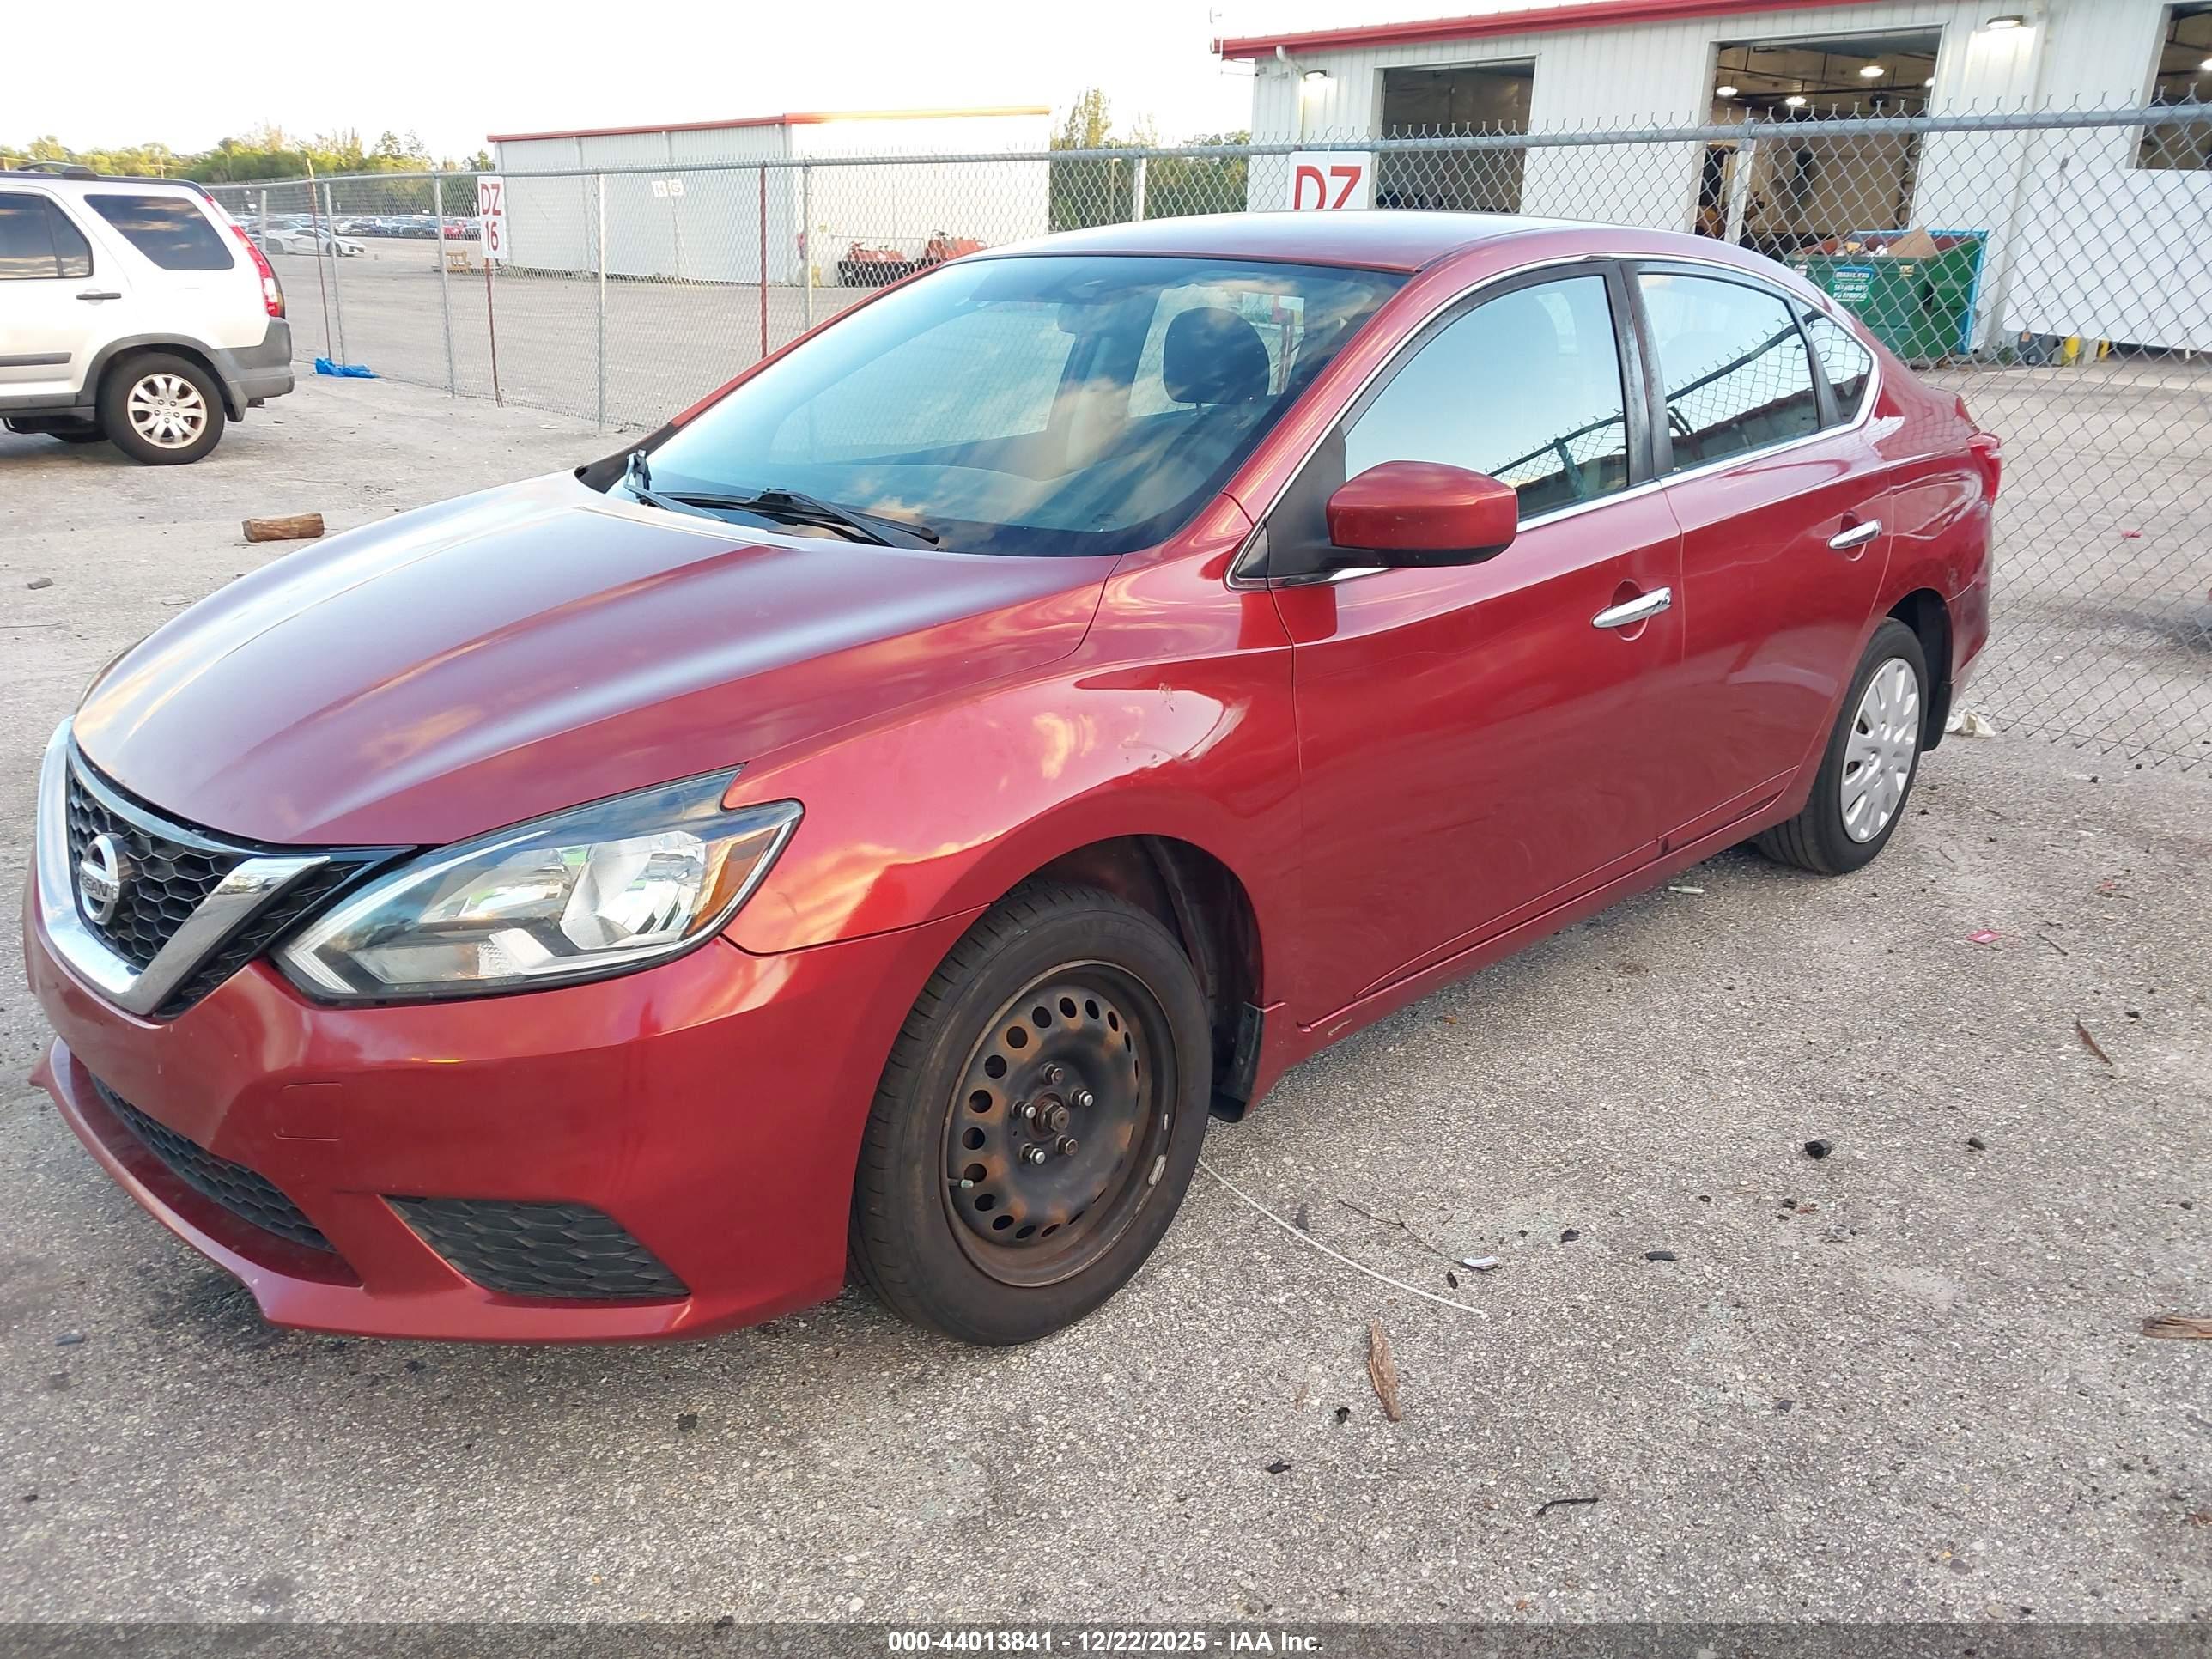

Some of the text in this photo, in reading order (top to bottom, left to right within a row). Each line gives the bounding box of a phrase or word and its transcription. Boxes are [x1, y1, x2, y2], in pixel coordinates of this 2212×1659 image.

[480, 183, 502, 216] DZ
[484, 221, 499, 252] 16
[82, 874, 109, 897] SSAN
